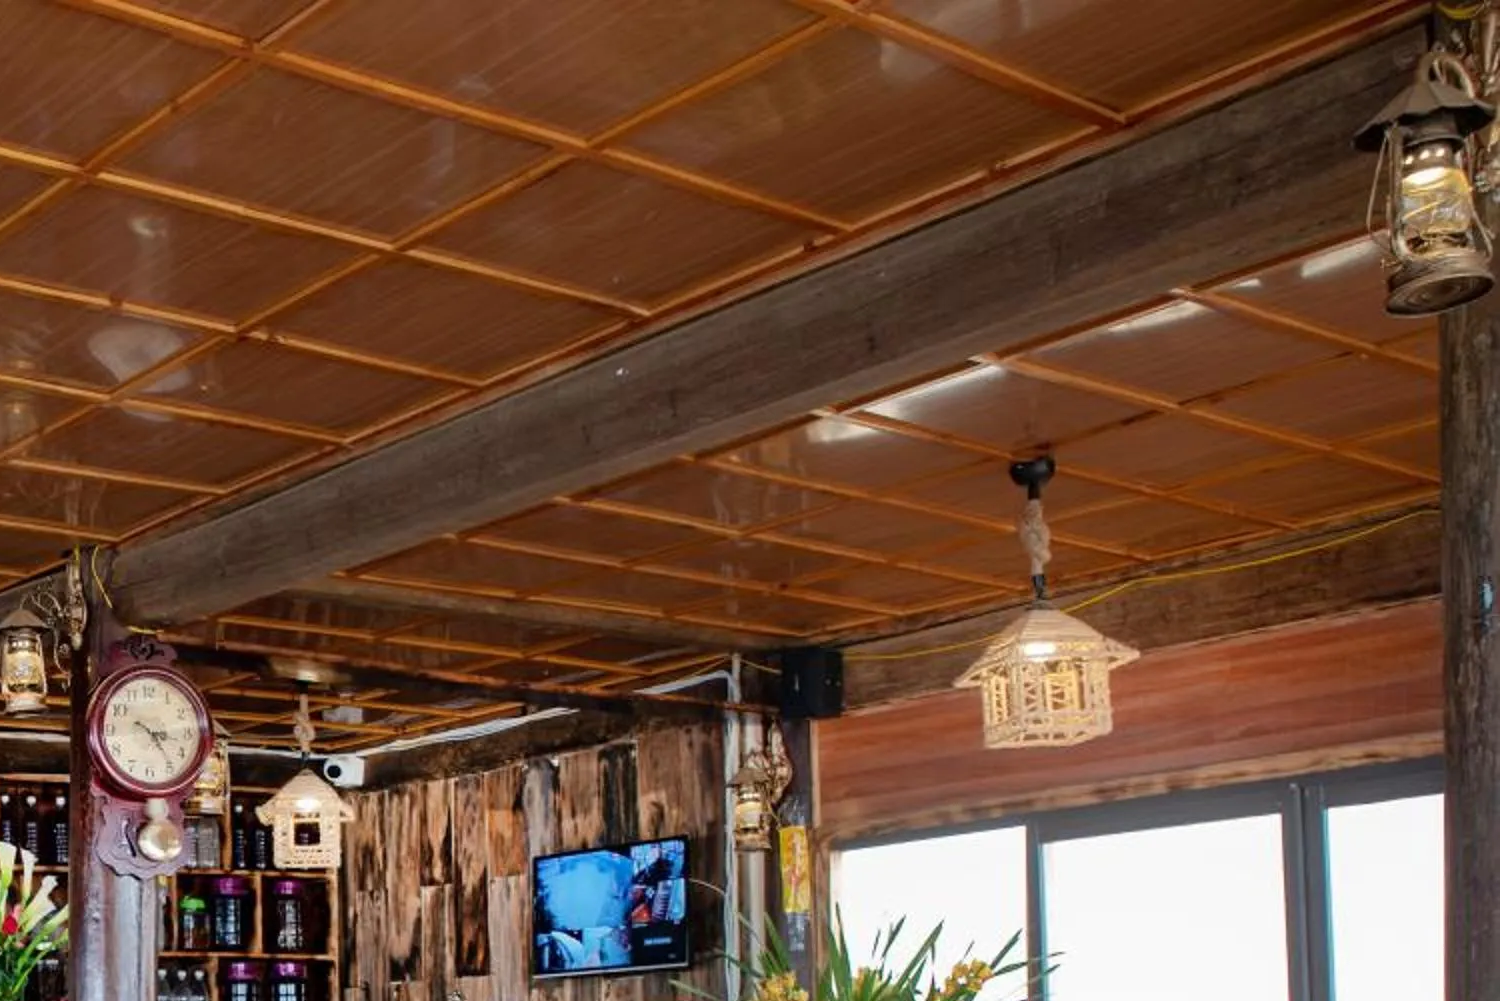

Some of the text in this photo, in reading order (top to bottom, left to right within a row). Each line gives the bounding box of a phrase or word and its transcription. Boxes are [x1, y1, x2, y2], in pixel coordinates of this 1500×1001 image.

[127, 689, 138, 701] 11
[142, 686, 157, 698] 12
[113, 703, 128, 716] 10
[177, 708, 185, 719] 2
[106, 724, 115, 736] 9
[184, 727, 193, 740] 3
[112, 744, 121, 756] 8
[177, 747, 185, 758] 4
[127, 759, 137, 772] 7
[166, 761, 174, 774] 5
[145, 766, 154, 778] 6
